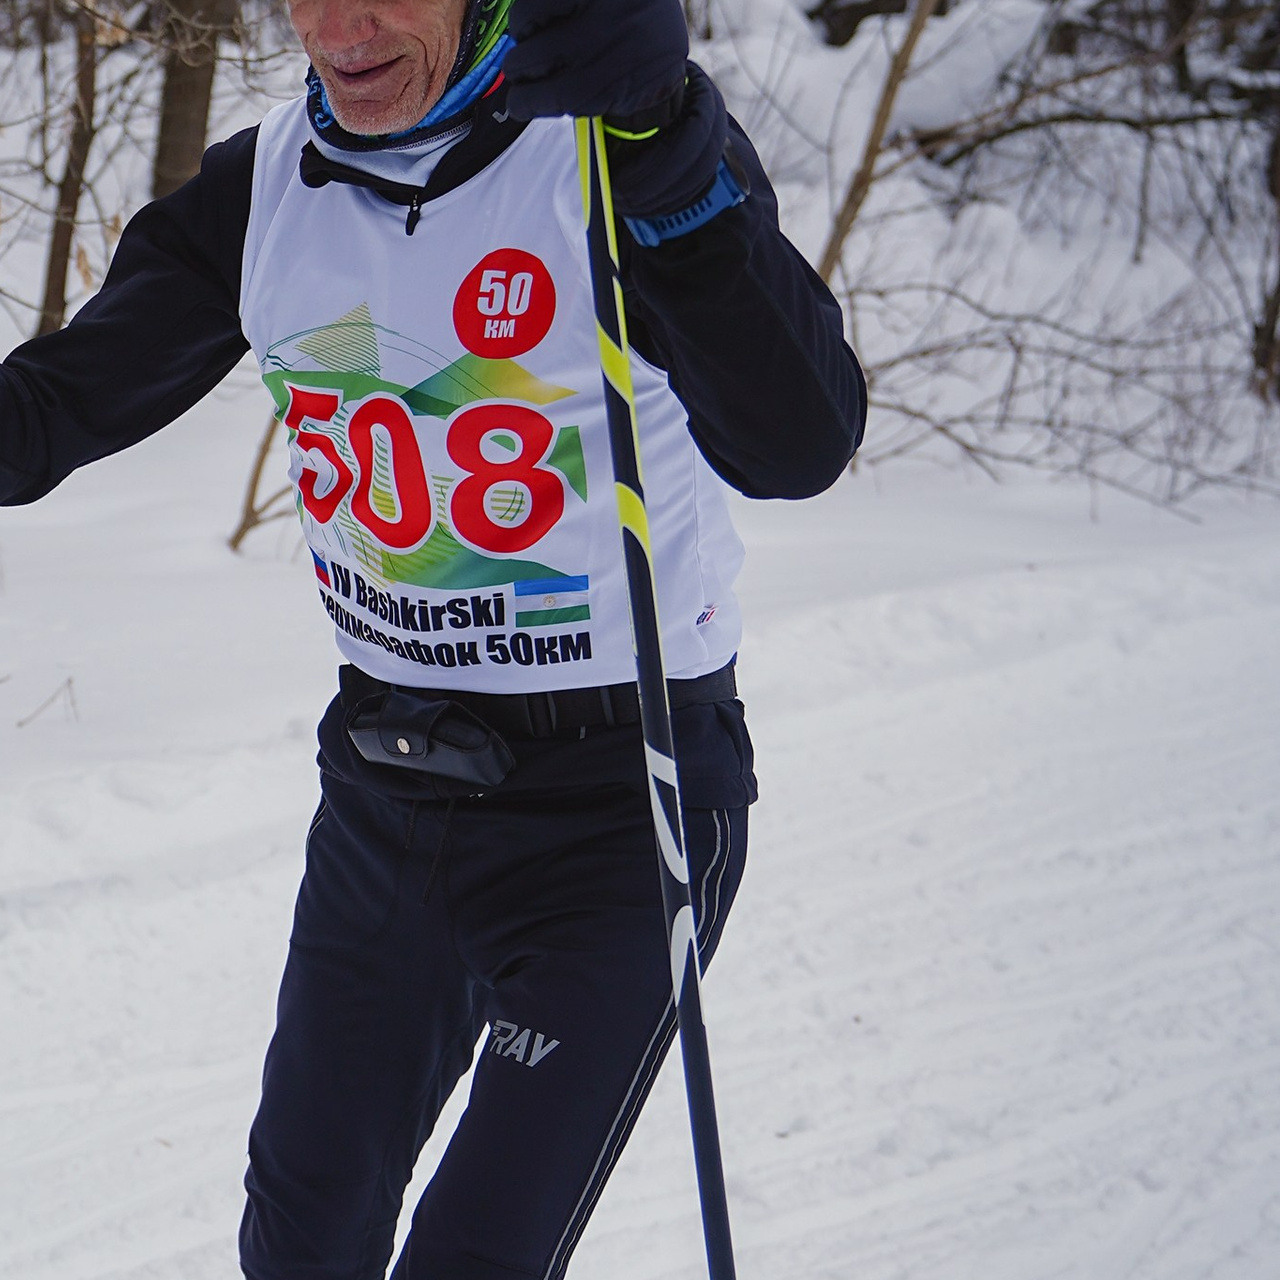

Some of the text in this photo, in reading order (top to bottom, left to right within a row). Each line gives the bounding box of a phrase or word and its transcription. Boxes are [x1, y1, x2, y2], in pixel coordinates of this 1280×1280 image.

[477, 270, 533, 316] 50
[285, 384, 565, 553] 508
[330, 561, 506, 632] IV BashkirSki
[490, 1019, 560, 1067] RAY
